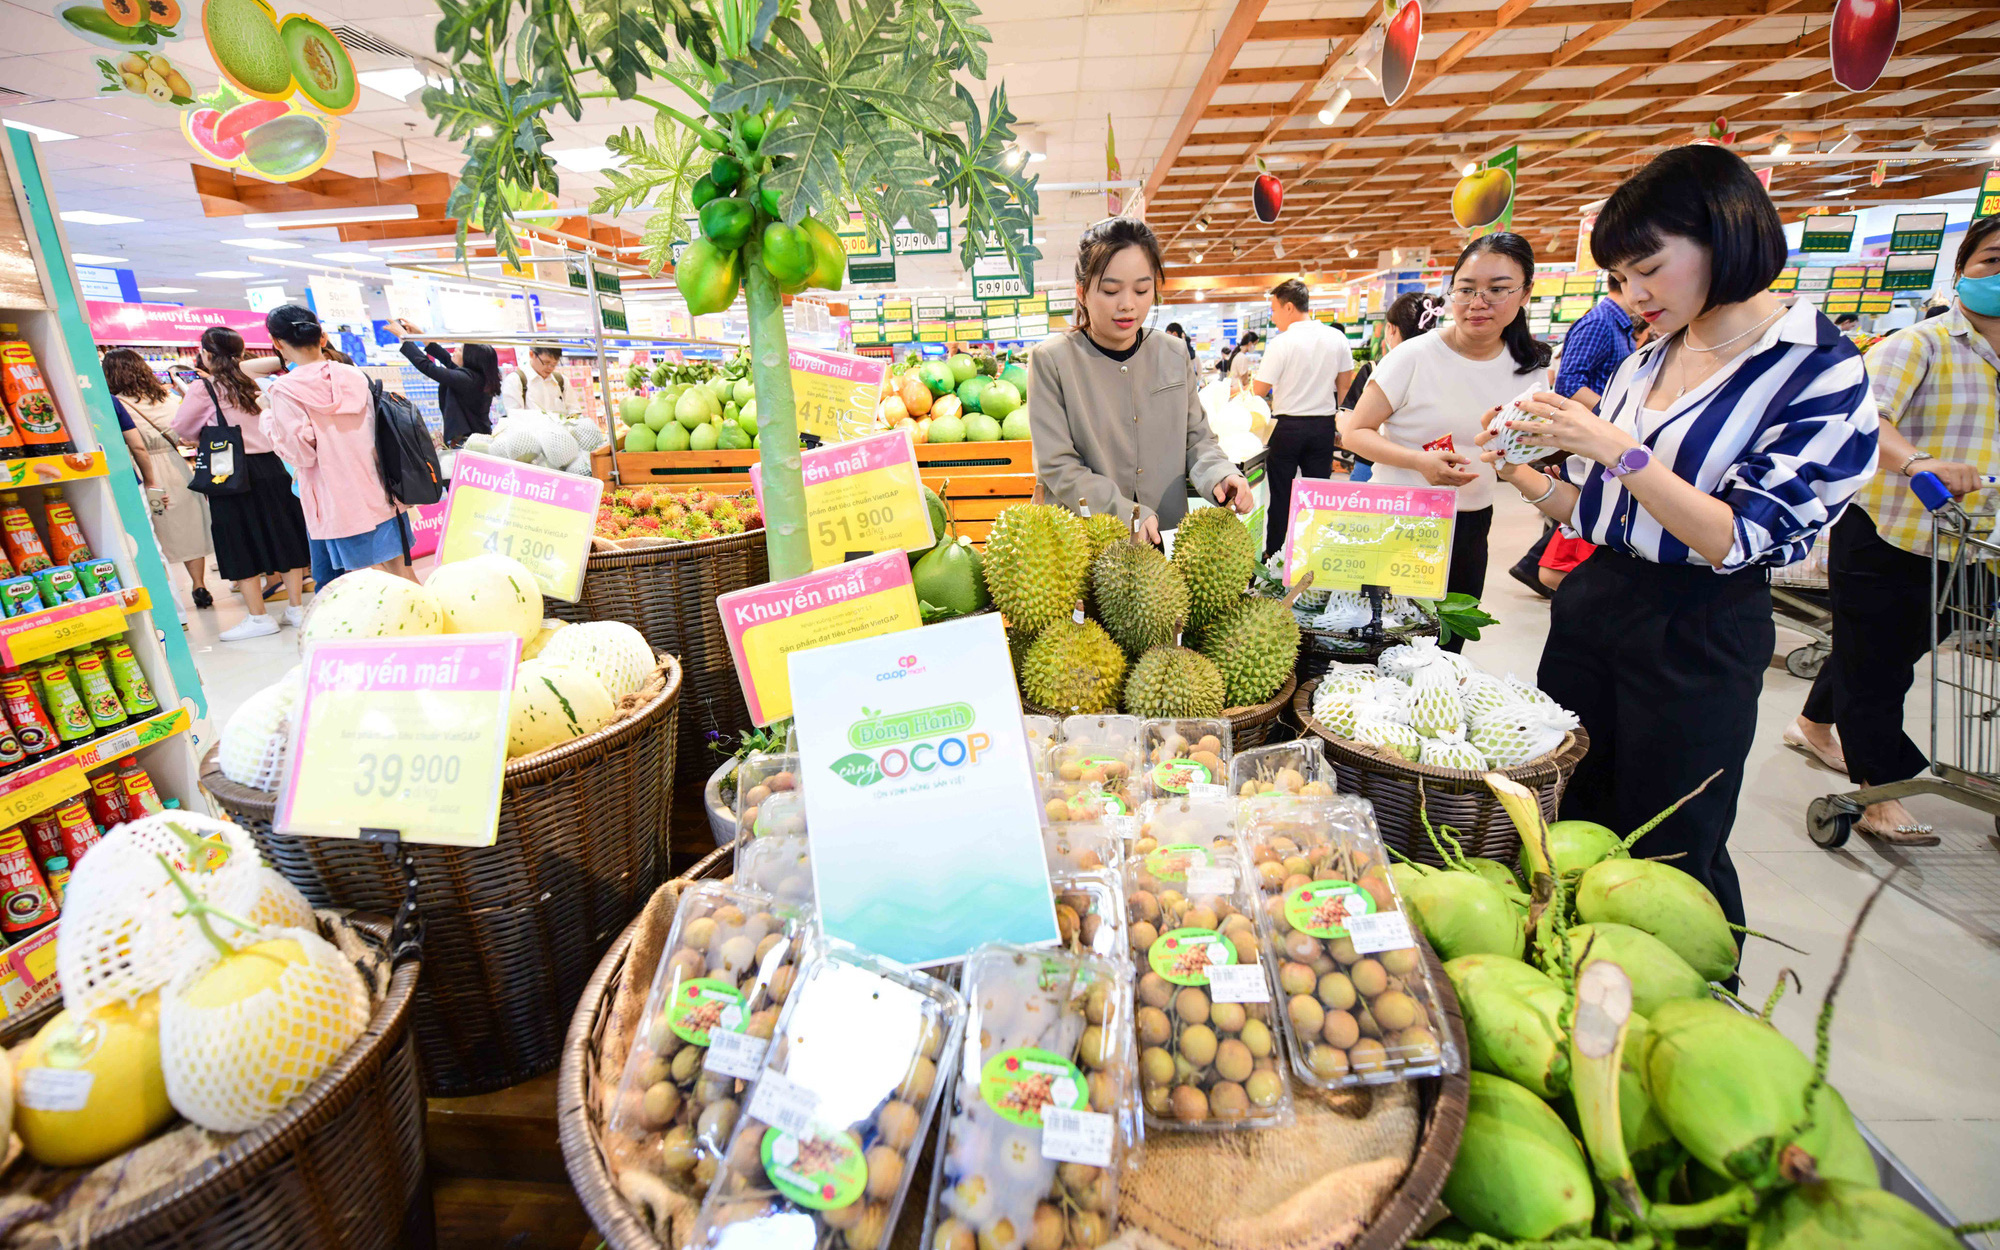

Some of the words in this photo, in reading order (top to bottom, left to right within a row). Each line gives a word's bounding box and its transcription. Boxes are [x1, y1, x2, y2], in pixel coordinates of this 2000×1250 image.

[978, 279, 1020, 295] 59.900
[203, 312, 226, 325] MÃI
[788, 351, 826, 372] huyến
[828, 362, 854, 377] mãi
[833, 450, 869, 476] mãi
[459, 464, 521, 493] Khuyến
[524, 478, 558, 501] mãi
[871, 489, 899, 503] VietGAP
[1297, 490, 1371, 511] Khuyến
[1376, 495, 1411, 512] mãi
[410, 510, 444, 532] Khuyế
[54, 573, 73, 583] MILO
[96, 565, 114, 574] MILO
[11, 585, 32, 594] MILO
[734, 584, 822, 626] Khuyến
[827, 575, 867, 600] mãi
[779, 645, 795, 654] Sản
[795, 637, 818, 651] phẩm
[818, 633, 831, 645] đạt
[831, 629, 847, 640] tiêu
[847, 621, 870, 635] chuẩn
[869, 613, 900, 629] VietGAP
[316, 652, 408, 691] Khuyến
[413, 656, 461, 685] mãi
[860, 717, 911, 744] Đồng
[913, 708, 967, 734] Hành
[79, 750, 101, 768] AGG
[838, 760, 879, 788] cùng
[879, 732, 991, 778] OCOP
[17, 932, 54, 957] Khuyến
